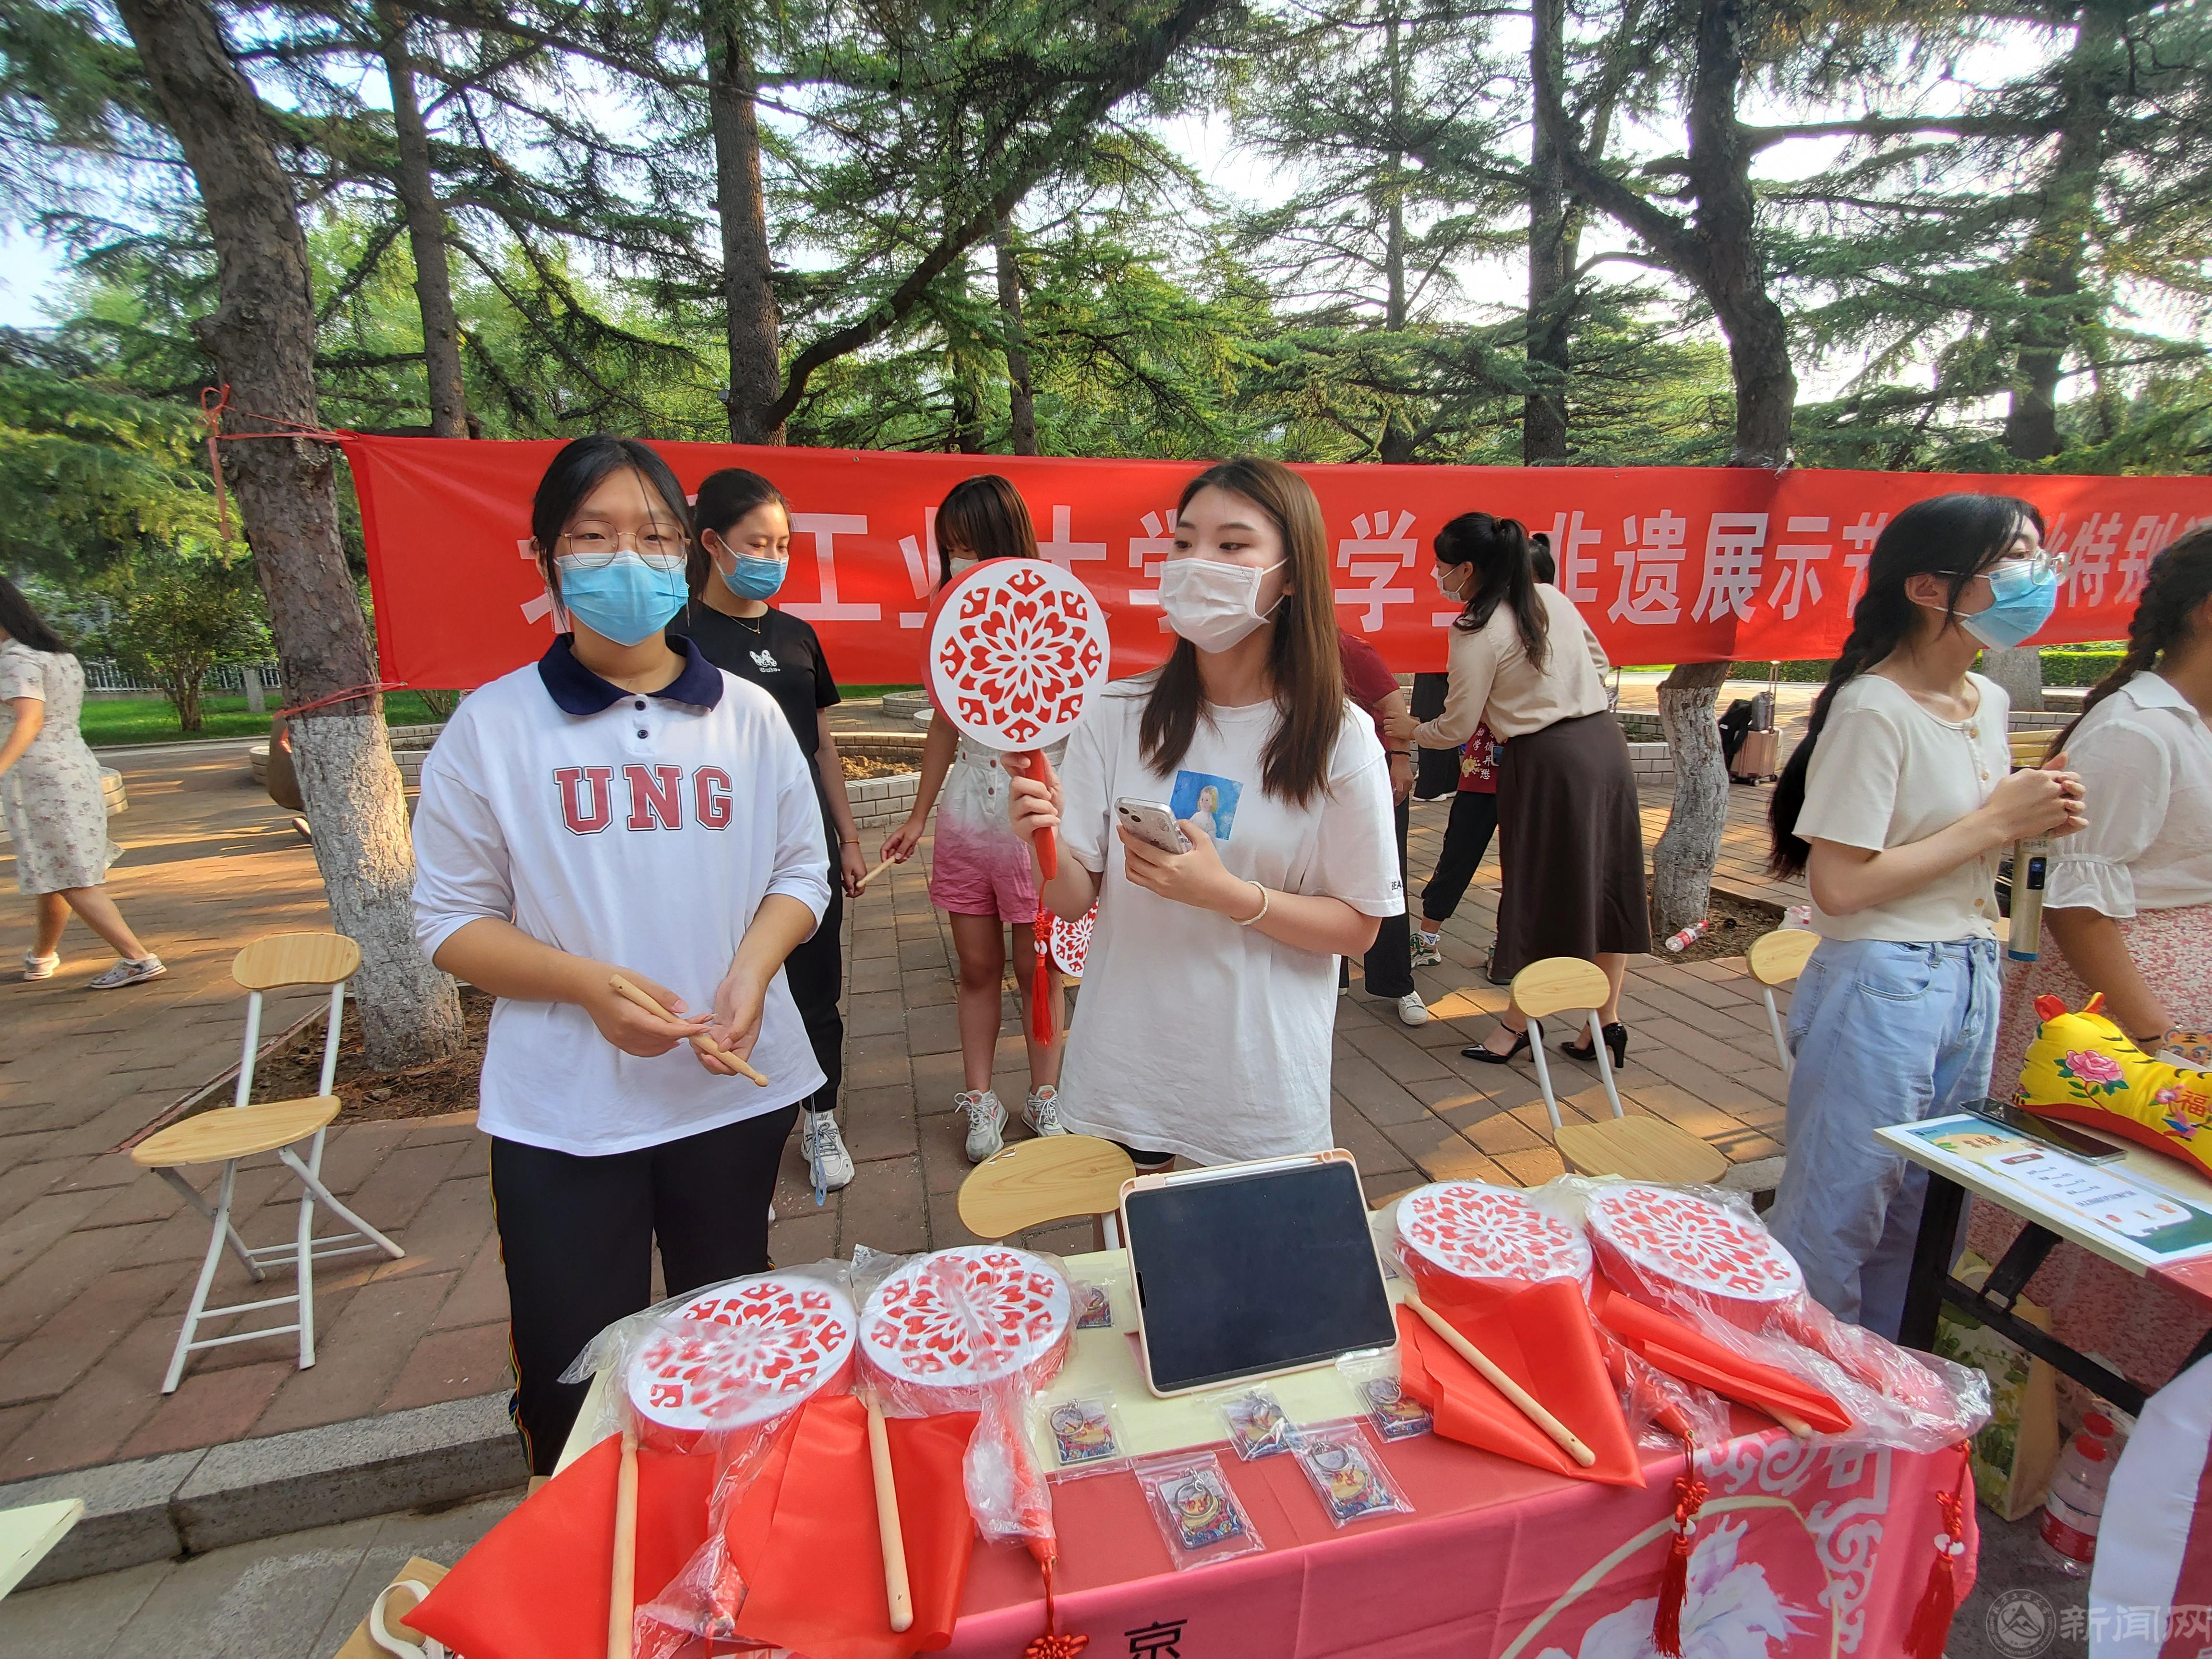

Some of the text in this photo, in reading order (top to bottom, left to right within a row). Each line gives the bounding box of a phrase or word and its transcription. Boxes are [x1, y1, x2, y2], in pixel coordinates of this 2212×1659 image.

[553, 764, 733, 836] UNG
[2181, 1090, 2211, 1118] 福
[1124, 1621, 1188, 1659] 京
